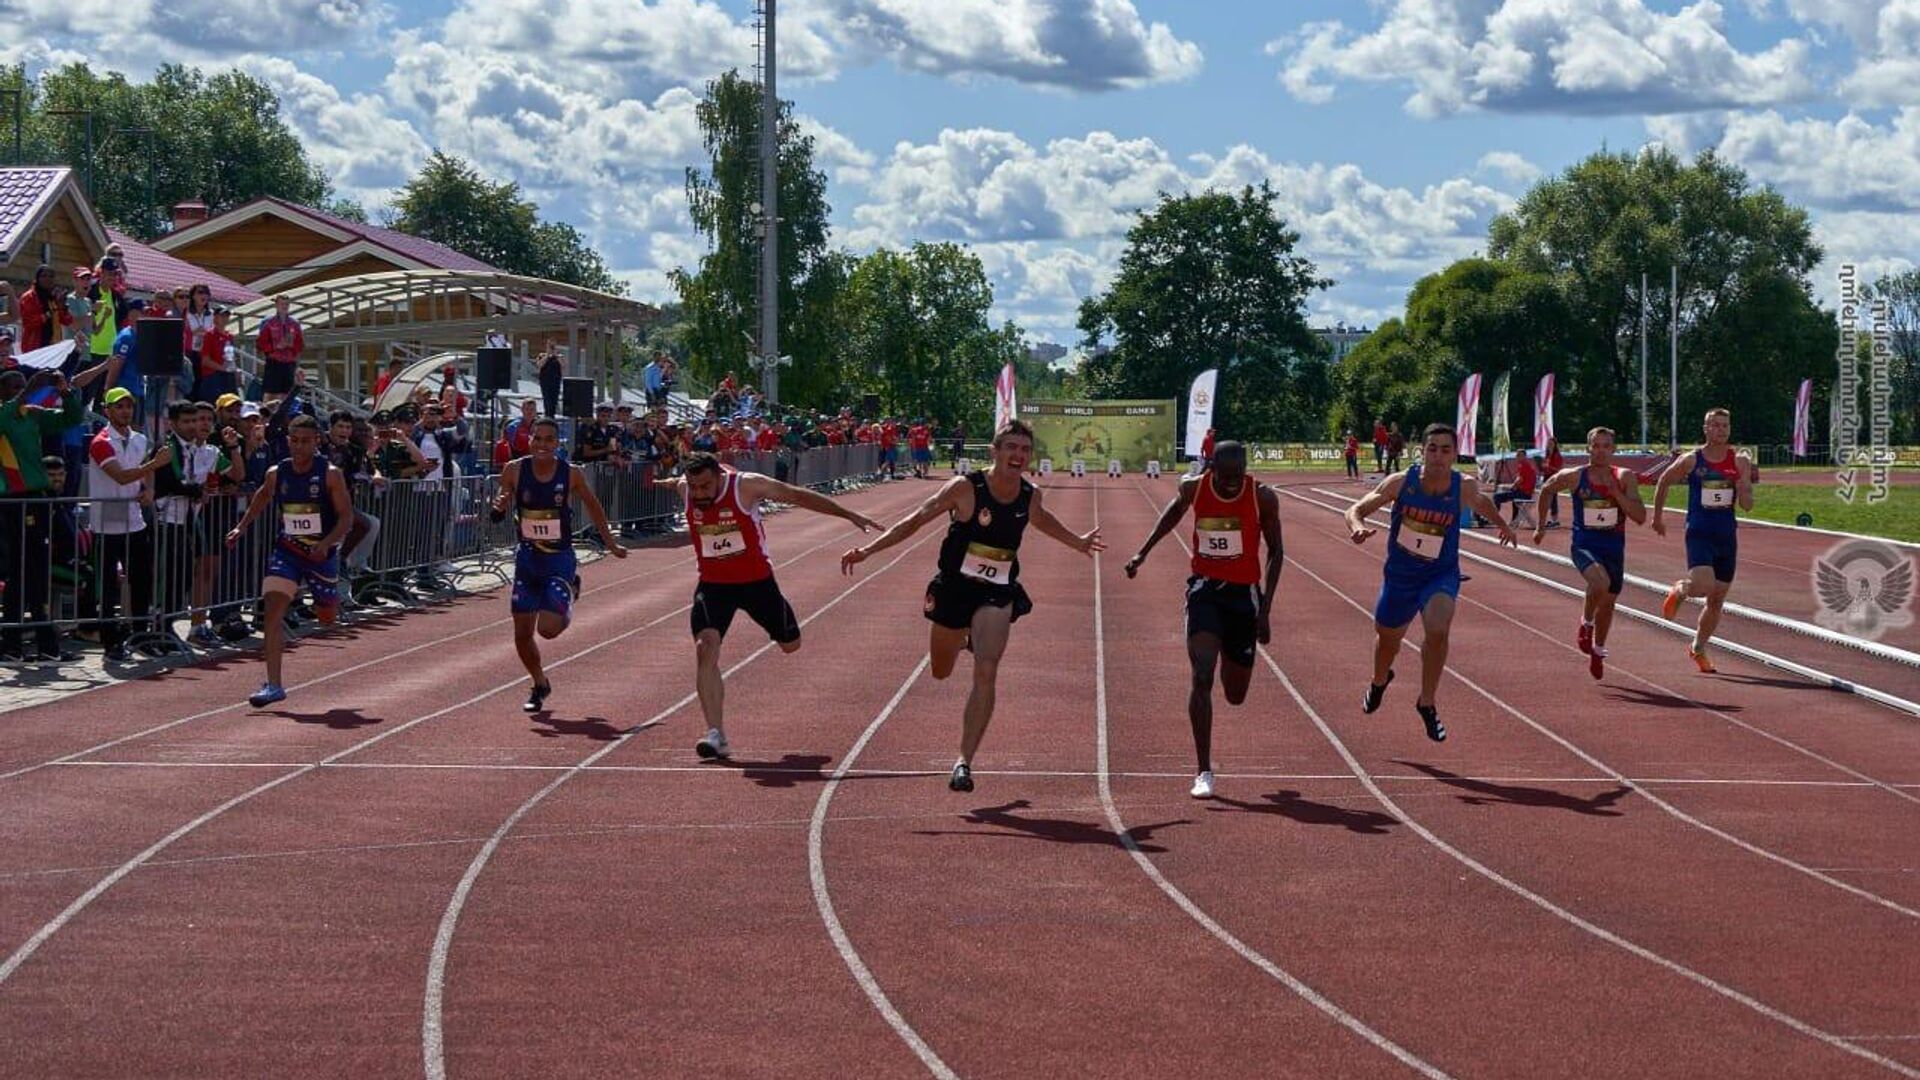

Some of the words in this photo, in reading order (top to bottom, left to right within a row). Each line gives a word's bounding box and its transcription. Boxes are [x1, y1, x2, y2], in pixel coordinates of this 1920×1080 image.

[1064, 406, 1093, 415] WORLD
[1126, 407, 1155, 415] GAMES
[1714, 493, 1722, 502] 5
[292, 519, 312, 530] 110
[532, 524, 549, 536] 111
[713, 538, 732, 551] 44
[1209, 537, 1229, 550] 58
[1416, 538, 1424, 549] 1
[977, 563, 998, 578] 70
